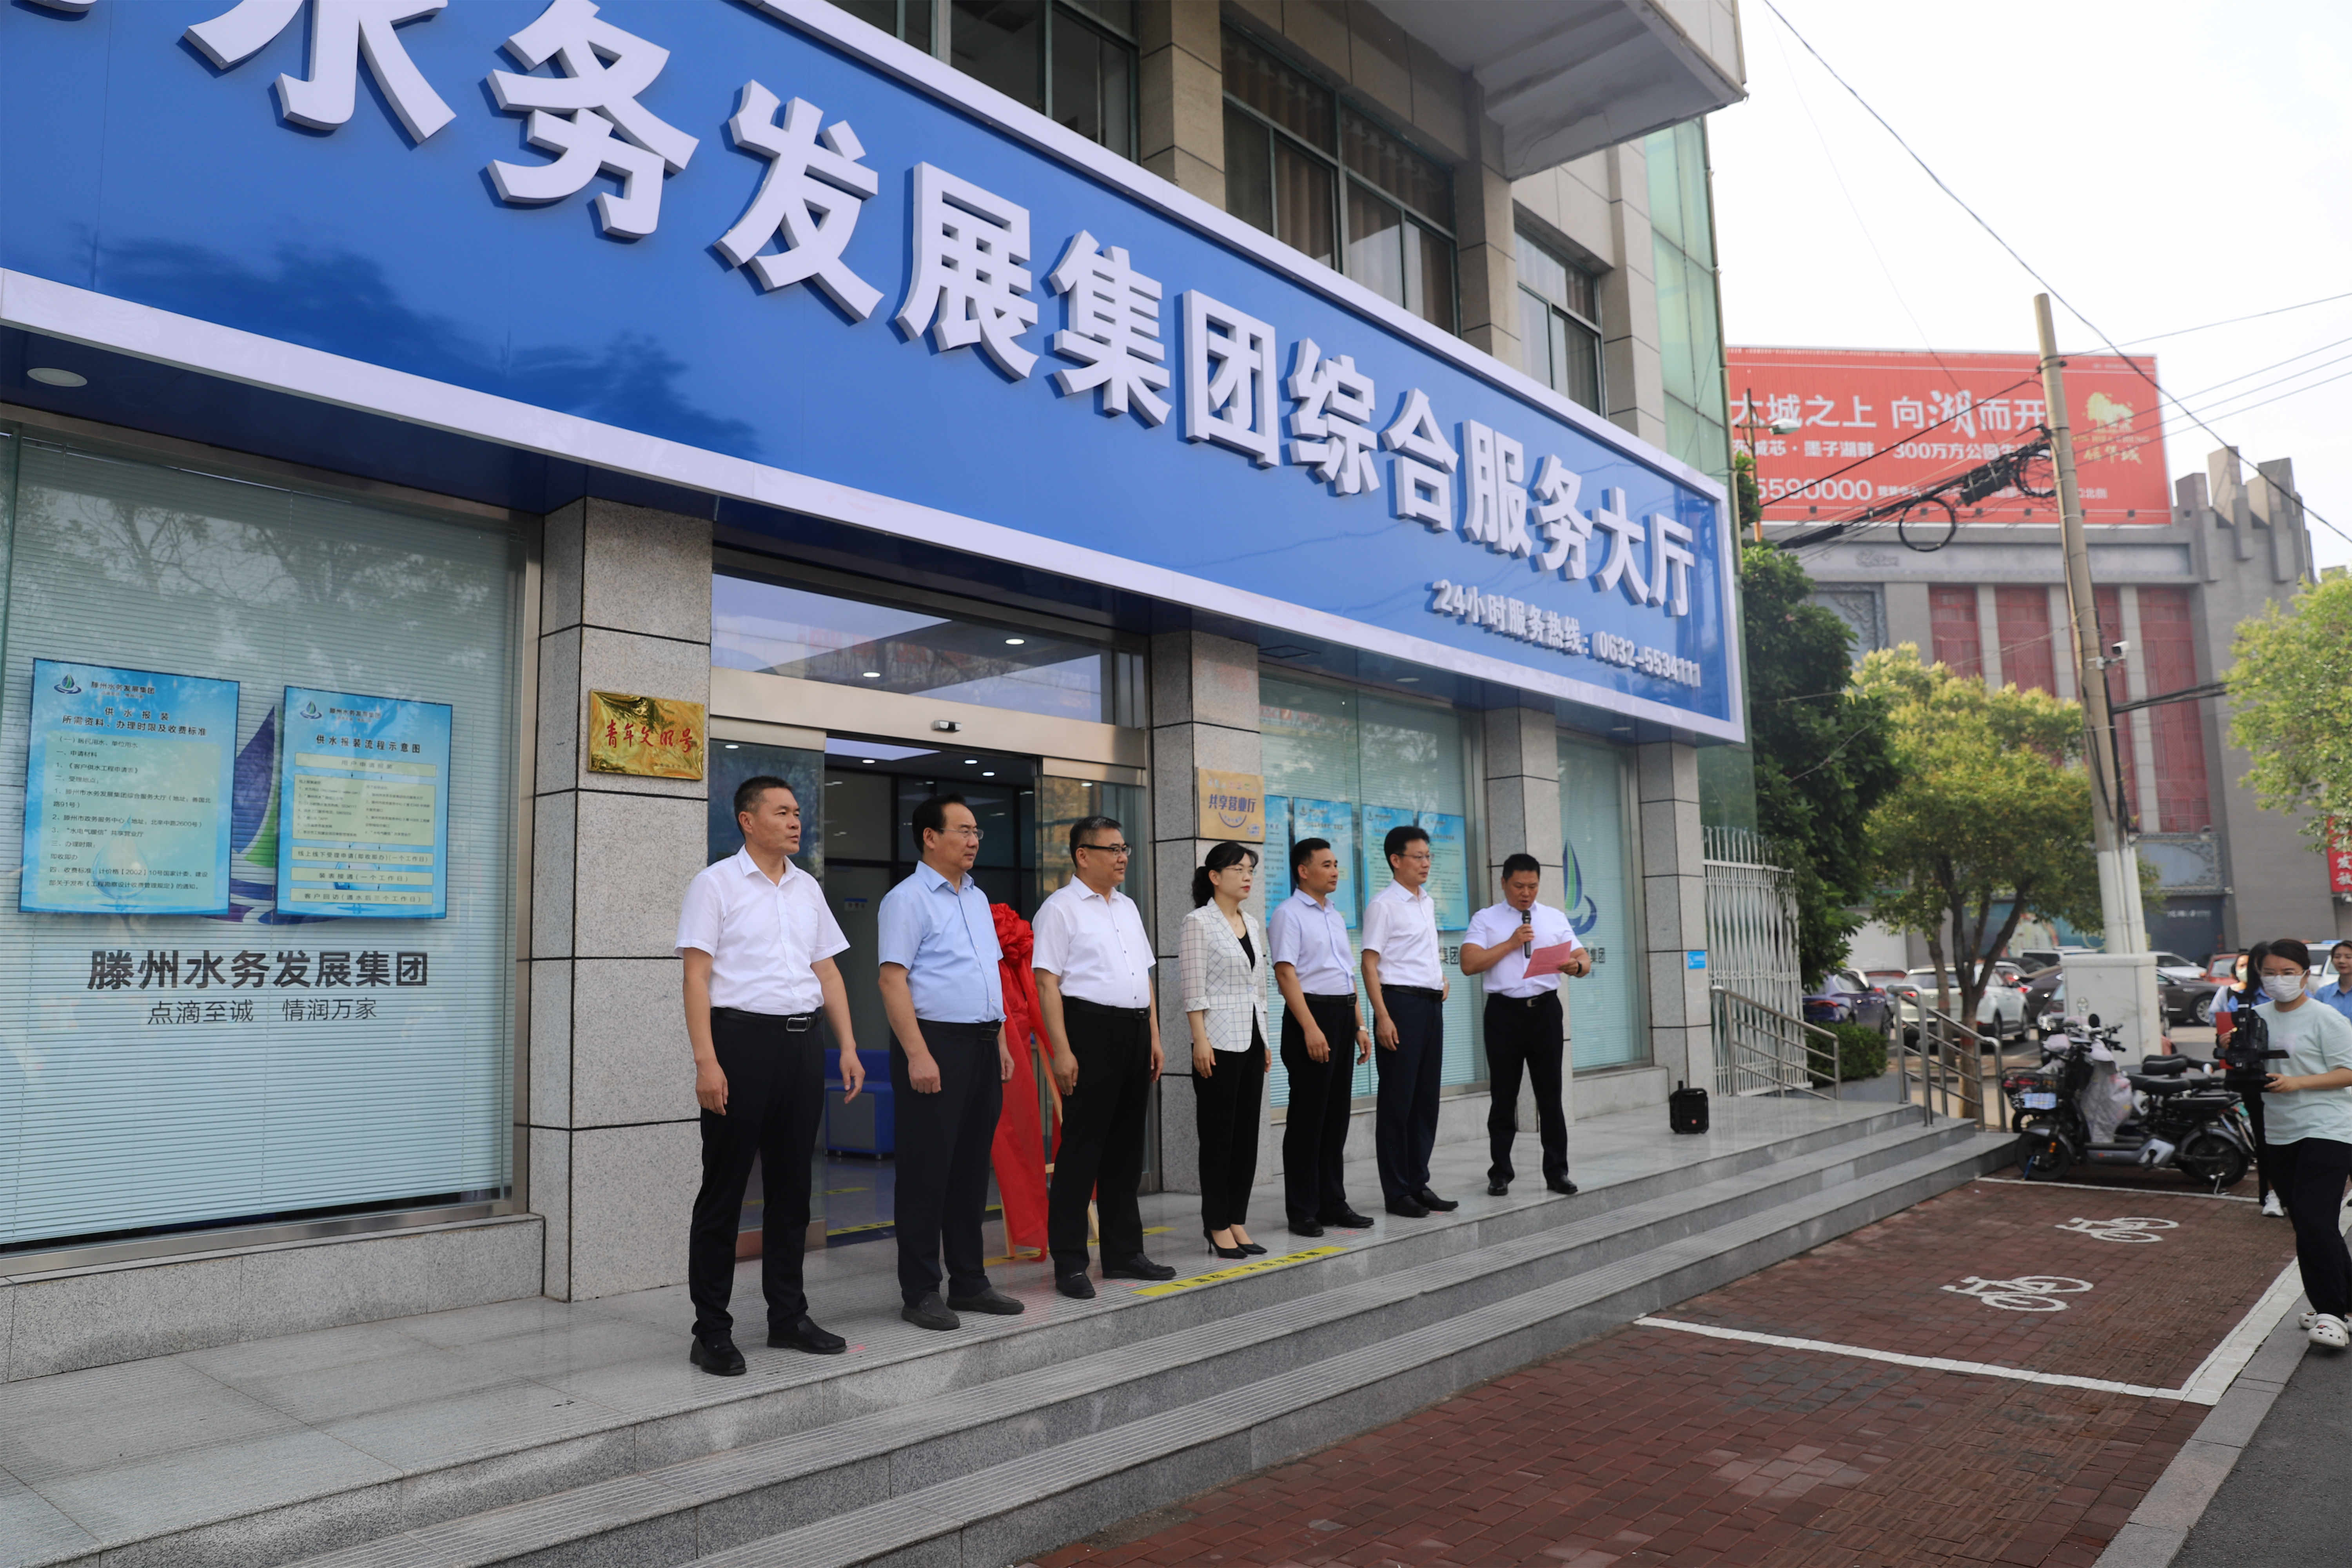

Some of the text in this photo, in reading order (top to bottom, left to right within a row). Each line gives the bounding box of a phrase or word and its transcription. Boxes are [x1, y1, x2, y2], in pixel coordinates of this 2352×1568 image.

[10, 0, 1695, 616] 水务发展集团综合服务大厅
[1730, 393, 1877, 427] 大城之上
[62, 715, 207, 736] 所需资料、办理时限及收费标准
[317, 734, 420, 753] 供水报装流程示意图
[1208, 793, 1257, 813] 共享营业厅
[87, 949, 428, 990] 滕州水务发展集团
[148, 997, 377, 1025] 点滴至诚 情润万家
